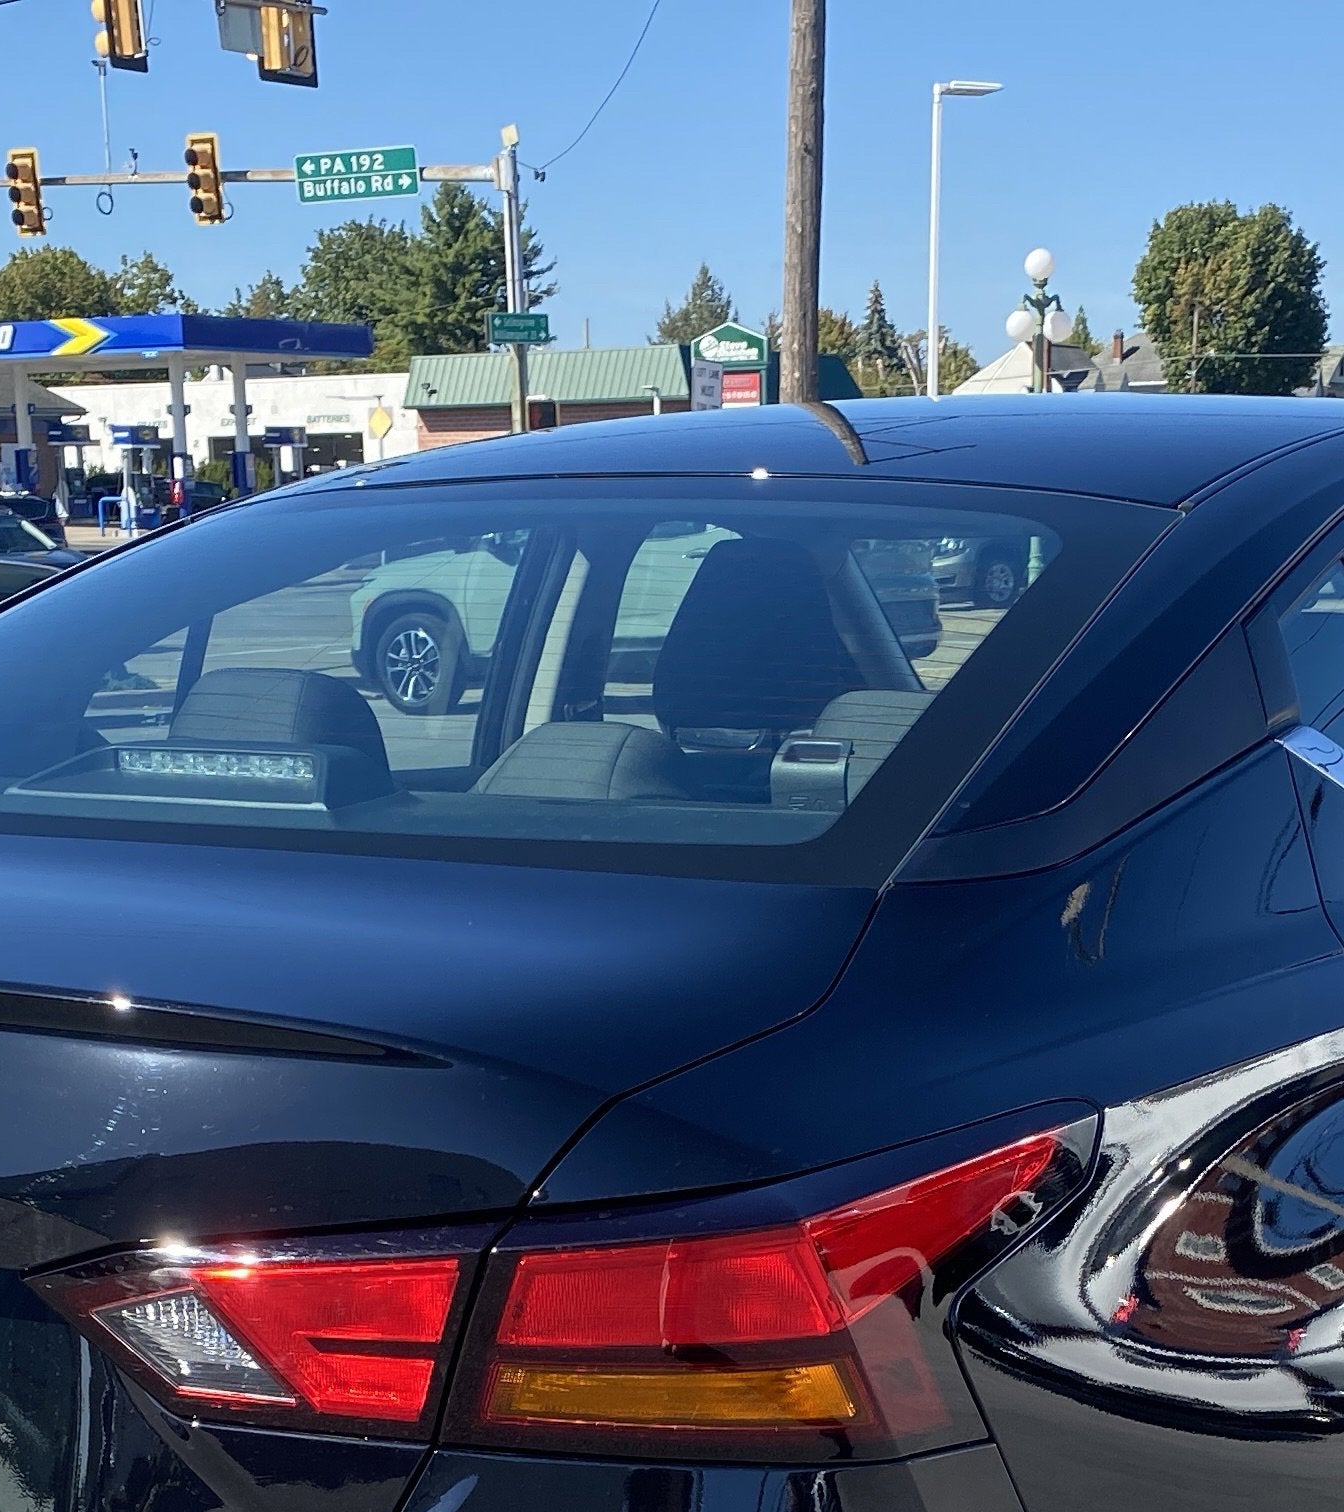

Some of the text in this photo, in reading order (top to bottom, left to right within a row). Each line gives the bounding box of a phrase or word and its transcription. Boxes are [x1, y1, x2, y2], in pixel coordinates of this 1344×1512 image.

[319, 153, 385, 175] PA 192
[303, 175, 393, 198] Buffalo Rd
[306, 414, 350, 424] BATTERIES
